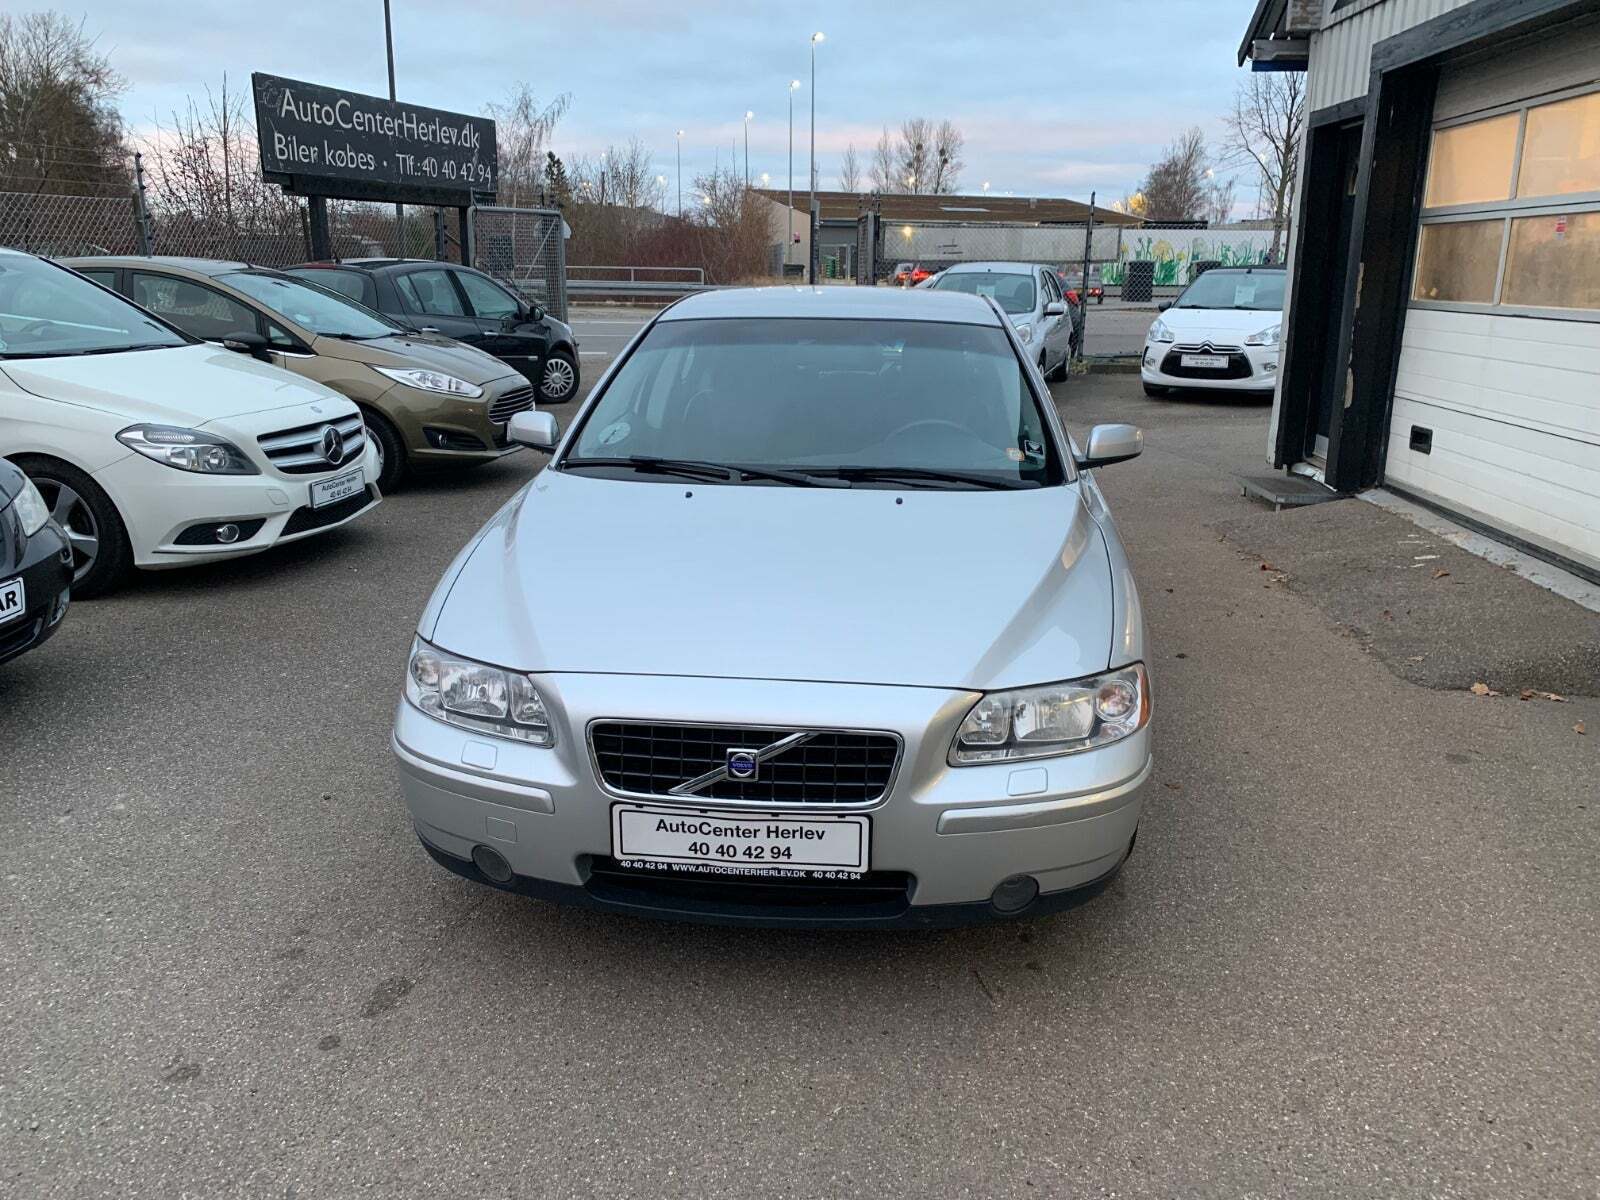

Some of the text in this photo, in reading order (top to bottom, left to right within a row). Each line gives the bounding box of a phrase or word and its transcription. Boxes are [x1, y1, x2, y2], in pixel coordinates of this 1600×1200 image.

[281, 88, 480, 149] AutoCenterHerlev.dk
[274, 132, 319, 163] Biler
[324, 140, 375, 171] købes
[442, 161, 457, 180] 40
[461, 163, 476, 182] 42
[478, 164, 491, 187] 94
[655, 818, 826, 841] AutoCenter Herlev
[688, 841, 793, 860] 40 40 42 94
[621, 861, 632, 869] 40
[632, 861, 643, 869] 40
[644, 862, 656, 870] 42
[672, 863, 807, 878] WWW.AUTOCENTERHERLEV.DK
[812, 871, 823, 879] 40
[824, 871, 836, 879] 40
[837, 871, 848, 880] 42
[849, 872, 861, 880] 94
